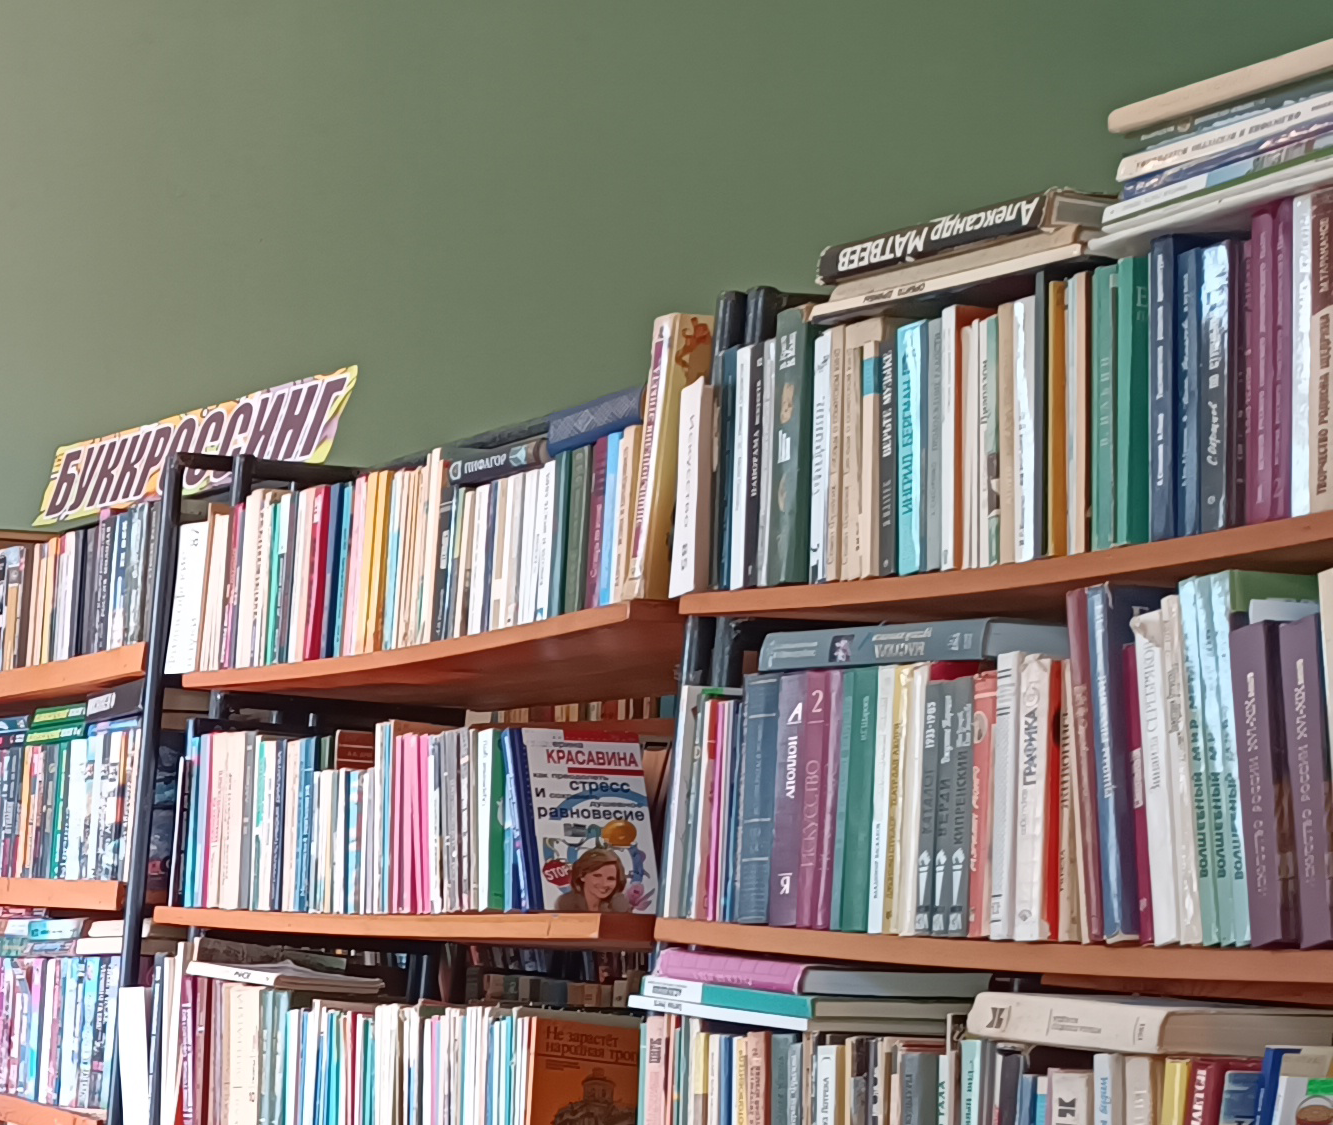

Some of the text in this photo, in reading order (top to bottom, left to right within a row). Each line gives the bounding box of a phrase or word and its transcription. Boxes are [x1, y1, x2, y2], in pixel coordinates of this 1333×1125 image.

[837, 198, 1039, 272] Александр МАТВЕЕВ
[881, 350, 893, 406] МУЗЫКЕ
[43, 374, 349, 520] БУККРОССИНГ
[463, 452, 507, 476] ПИФАГОР
[901, 452, 913, 516] ИНГРИД
[811, 688, 825, 714] 2
[545, 748, 639, 768] КРАСАВИНА
[1023, 706, 1039, 786] ГРАФИКА
[1297, 744, 1311, 802] РОССИИ
[569, 780, 631, 794] стресс
[953, 750, 969, 844] КИПРЕНСКИЙ
[1187, 718, 1209, 878] ВОЛШЕБНЫЙ МИР
[1249, 756, 1263, 812] РОССИИ
[537, 806, 645, 822] равновесие
[1209, 770, 1227, 878] ВОЛШЕБНЫЙ
[543, 864, 571, 882] STOP
[545, 1026, 619, 1048] Не зарастёт
[545, 1042, 605, 1058] народная
[649, 1038, 663, 1064] ЦИРК
